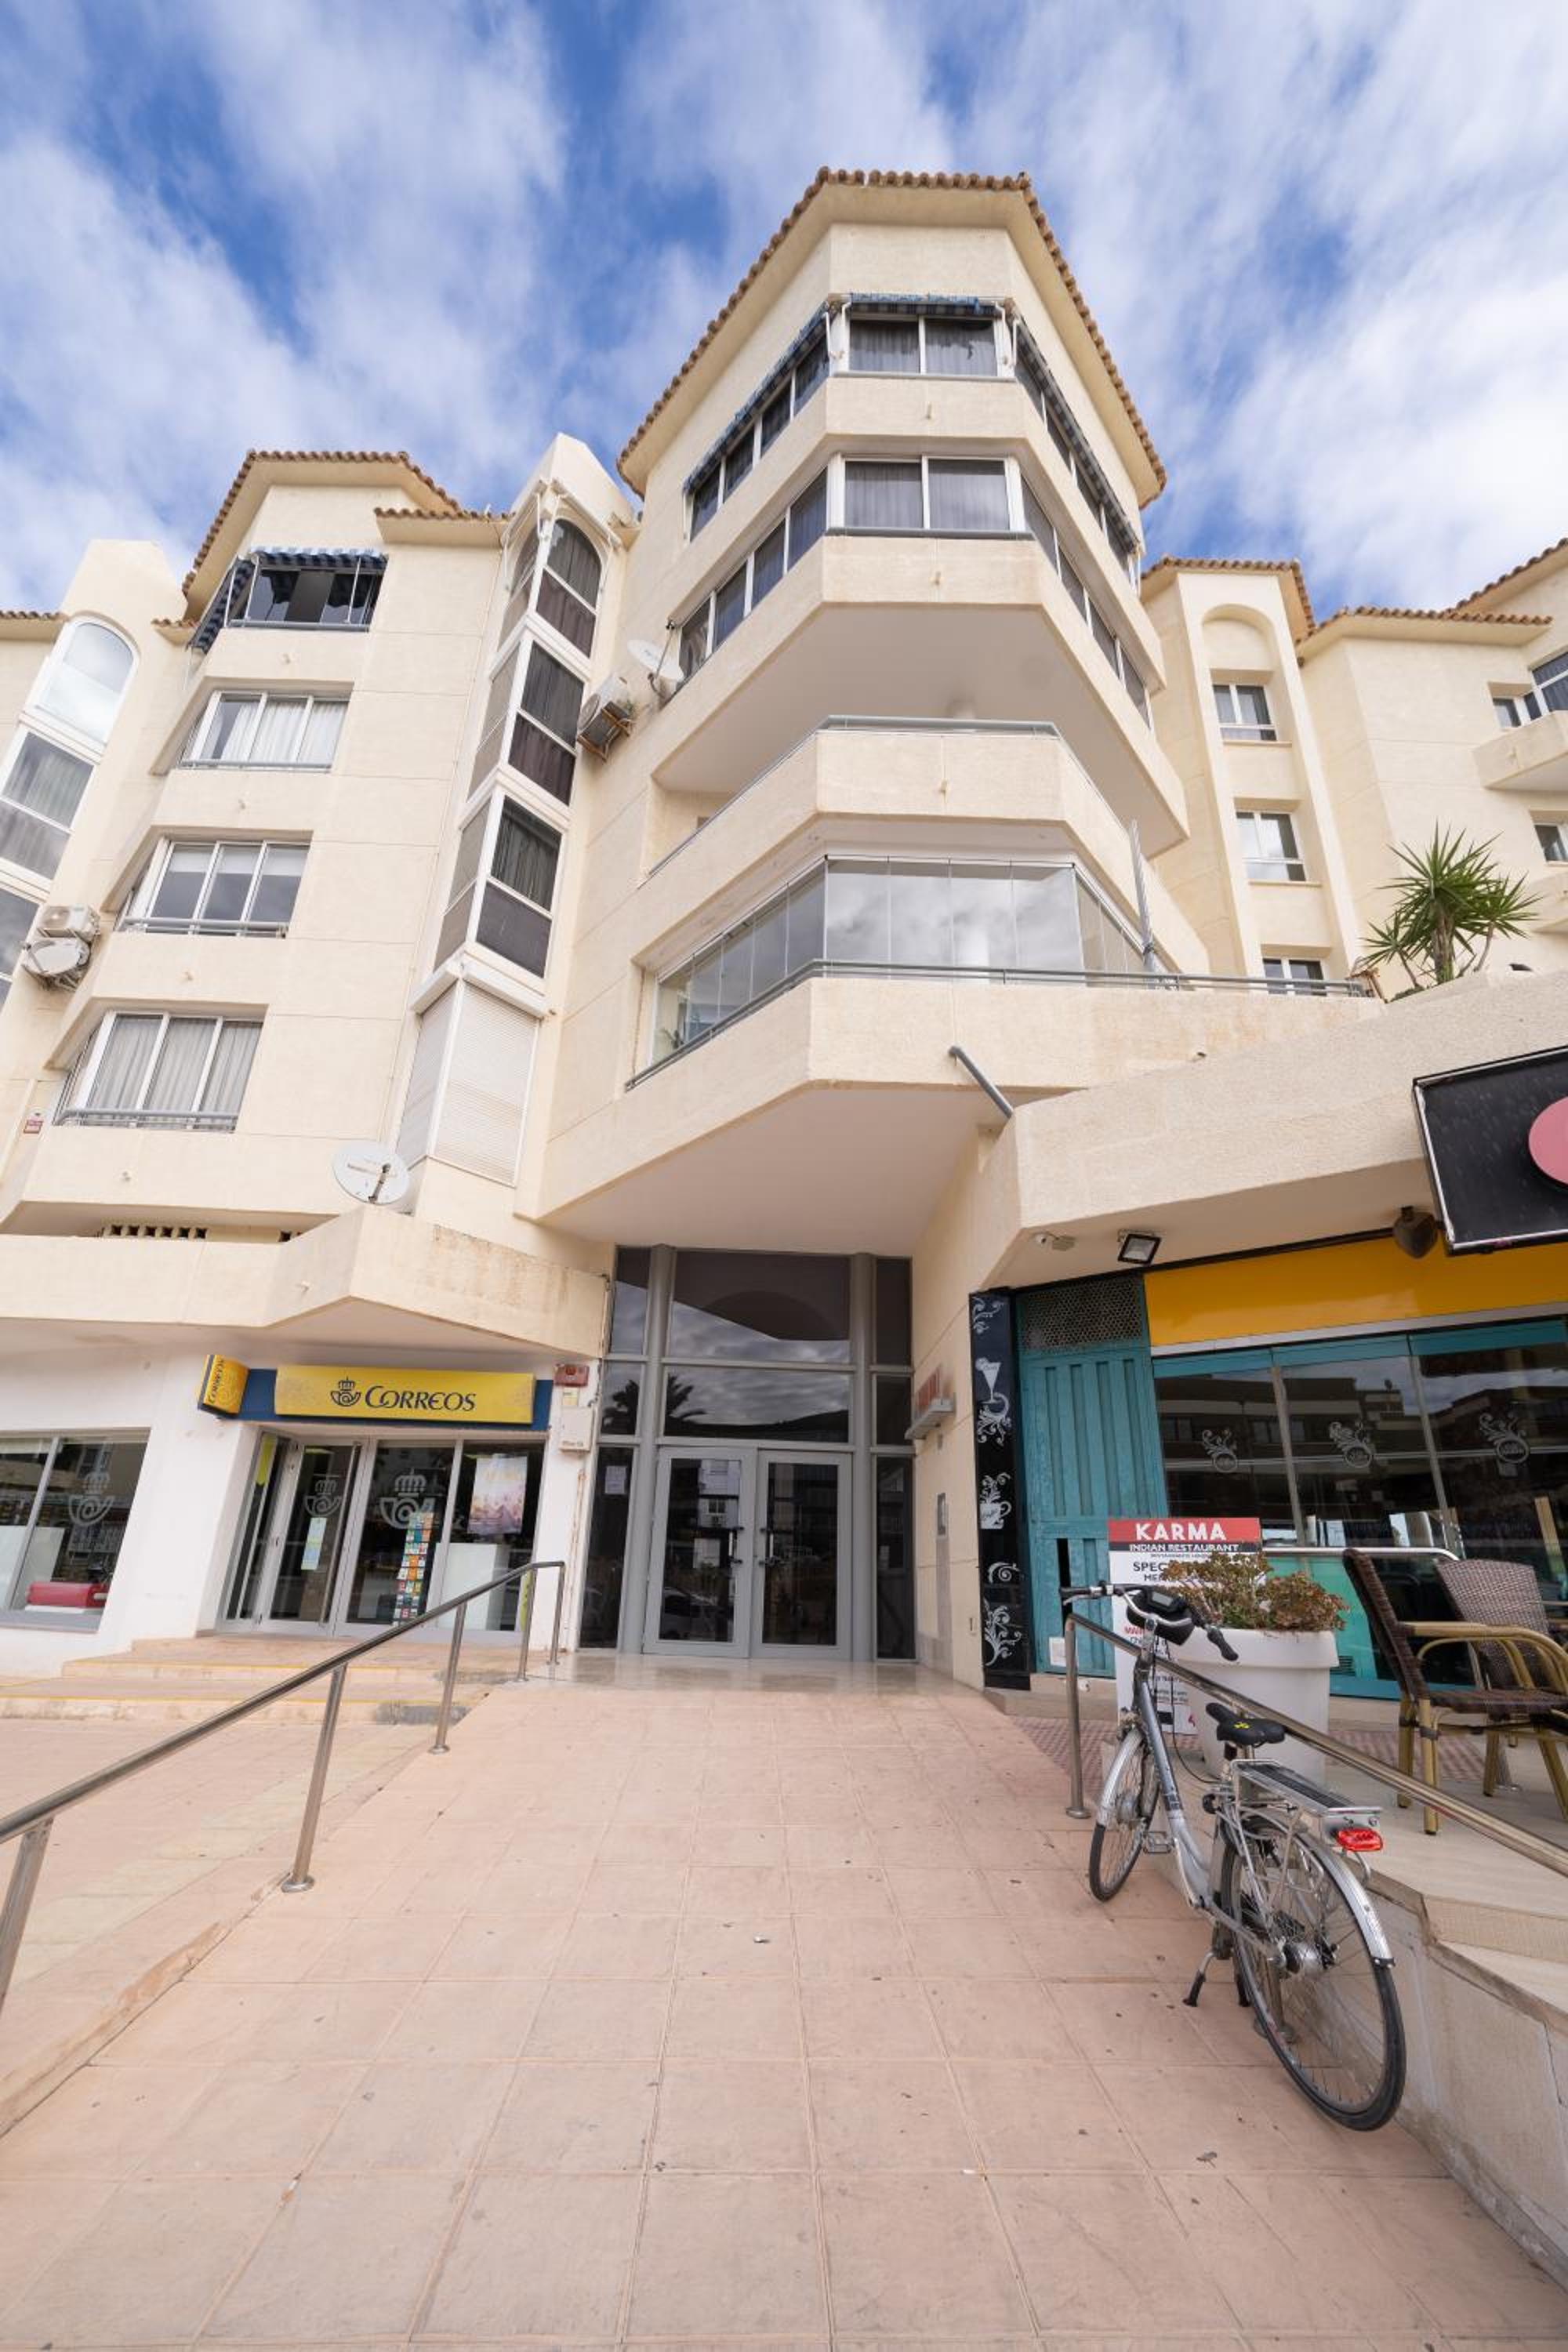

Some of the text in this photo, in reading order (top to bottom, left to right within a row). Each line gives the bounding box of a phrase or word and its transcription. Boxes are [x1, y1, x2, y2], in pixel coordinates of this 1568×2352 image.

[365, 1385, 477, 1411] CORREOS
[1136, 1523, 1227, 1541] KARMA
[1133, 1561, 1167, 1572] SPEC
